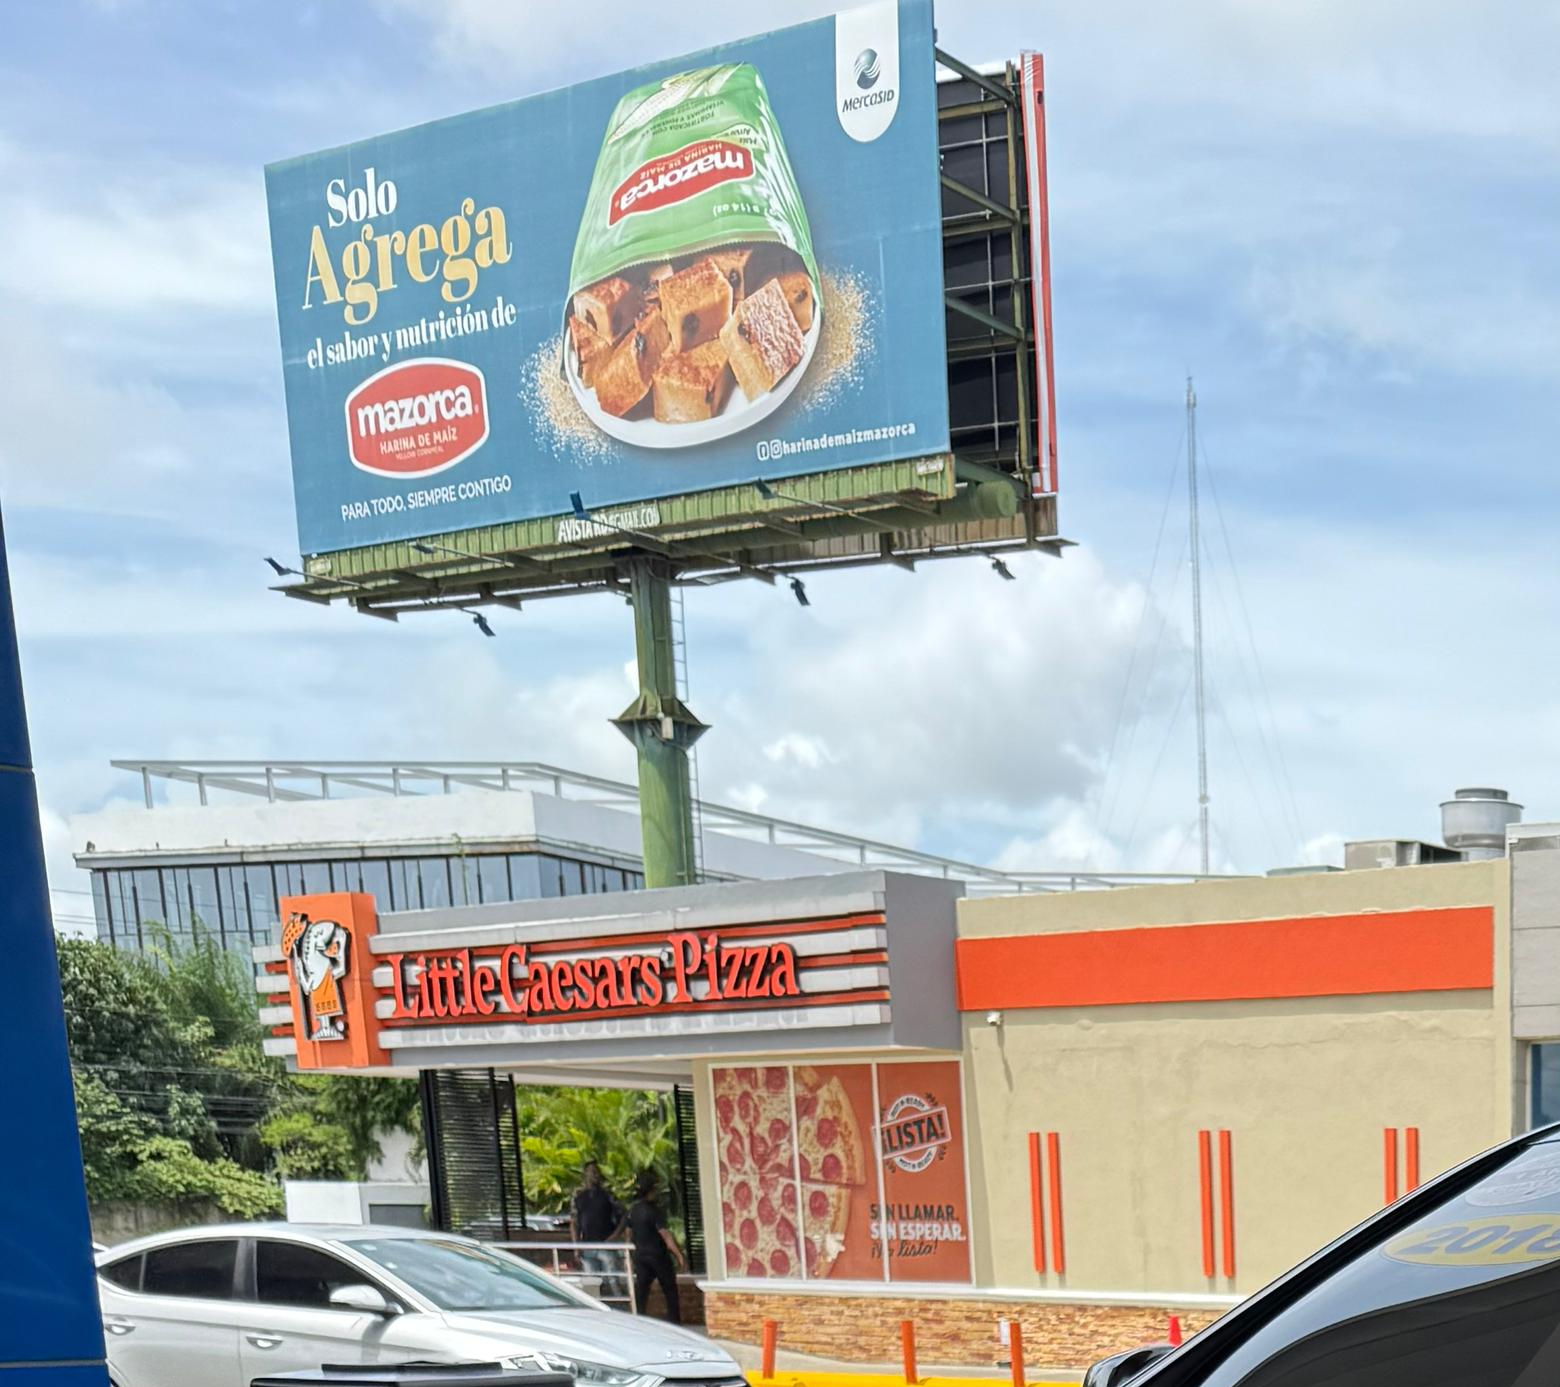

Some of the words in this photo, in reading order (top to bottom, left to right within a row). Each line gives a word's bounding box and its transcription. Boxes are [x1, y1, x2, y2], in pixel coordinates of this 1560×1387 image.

[326, 167, 397, 229] Solo
[619, 150, 744, 212] mazorca
[302, 197, 513, 326] Agrega
[307, 337, 324, 369] el
[326, 329, 379, 365] sabor
[380, 331, 393, 361] y
[396, 303, 488, 350] nutrición
[491, 296, 517, 328] de
[356, 384, 474, 438] mazorca
[379, 436, 416, 455] HARINA
[418, 432, 432, 447] DE
[341, 502, 372, 522] PARA
[371, 494, 407, 514] TODO,
[408, 485, 456, 509] SIEMPRE
[458, 475, 512, 499] CONTIGO
[388, 948, 497, 1019] Little
[501, 943, 664, 1013] Caesars
[668, 931, 800, 1003] Pizza
[870, 1203, 895, 1221] SN
[870, 1221, 897, 1241] SN
[899, 1221, 967, 1242] ESPERAR.
